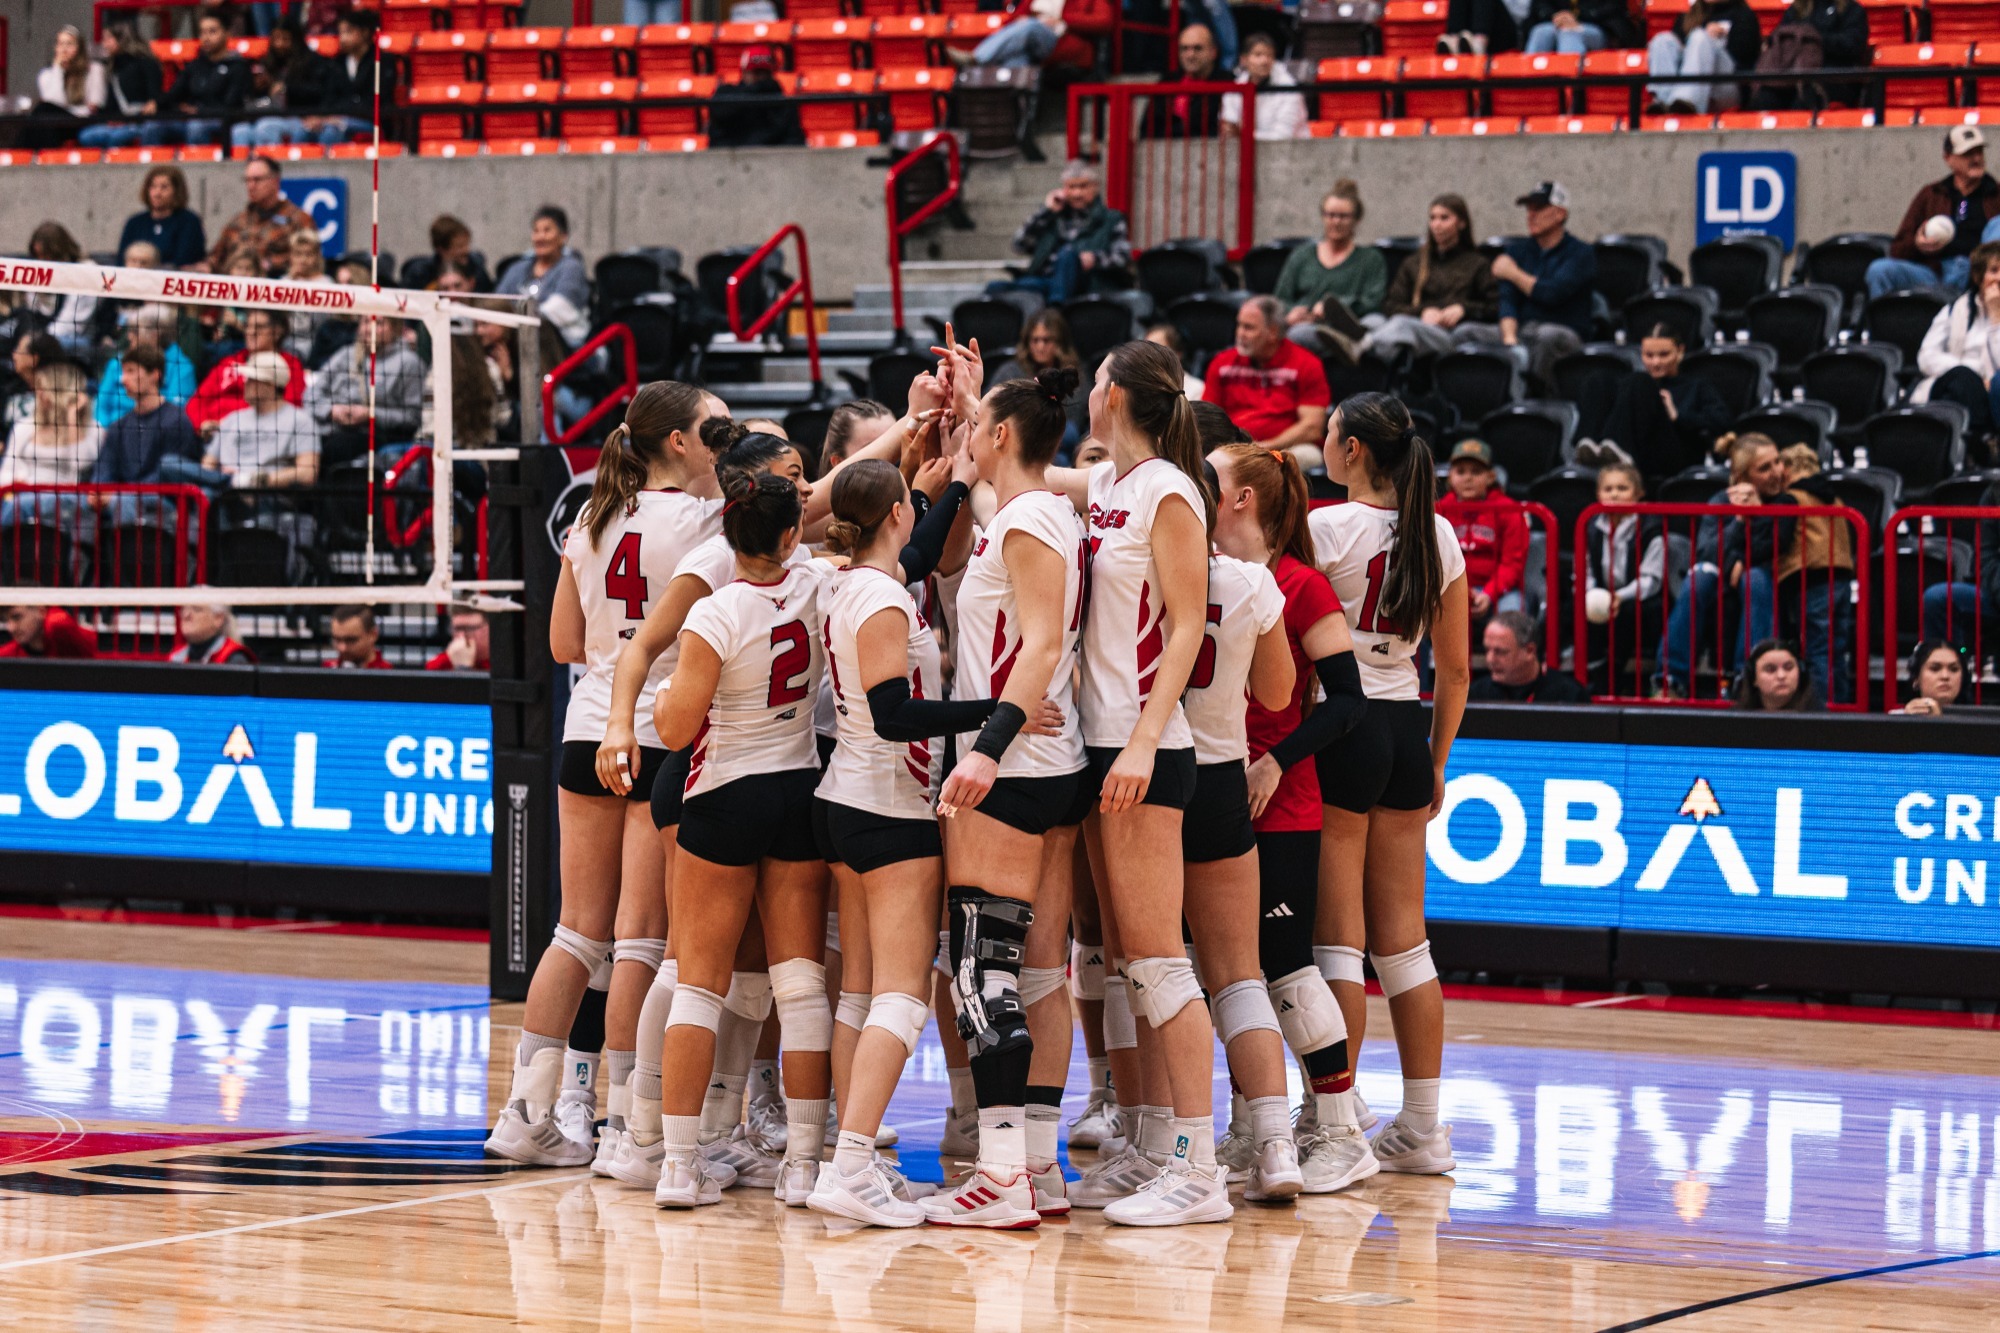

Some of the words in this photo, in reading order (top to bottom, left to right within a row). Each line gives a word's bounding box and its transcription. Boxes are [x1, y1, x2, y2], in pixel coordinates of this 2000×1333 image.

[1704, 166, 1784, 223] LD
[162, 277, 242, 301] EASTERN
[245, 284, 355, 309] WASHINGTON
[605, 532, 648, 620] 4
[1355, 550, 1406, 634] 1
[767, 619, 810, 708] 2
[385, 735, 490, 781] CRE
[1426, 773, 1848, 900] OBAL
[1895, 791, 2000, 842] CR
[1893, 857, 2000, 906] UN
